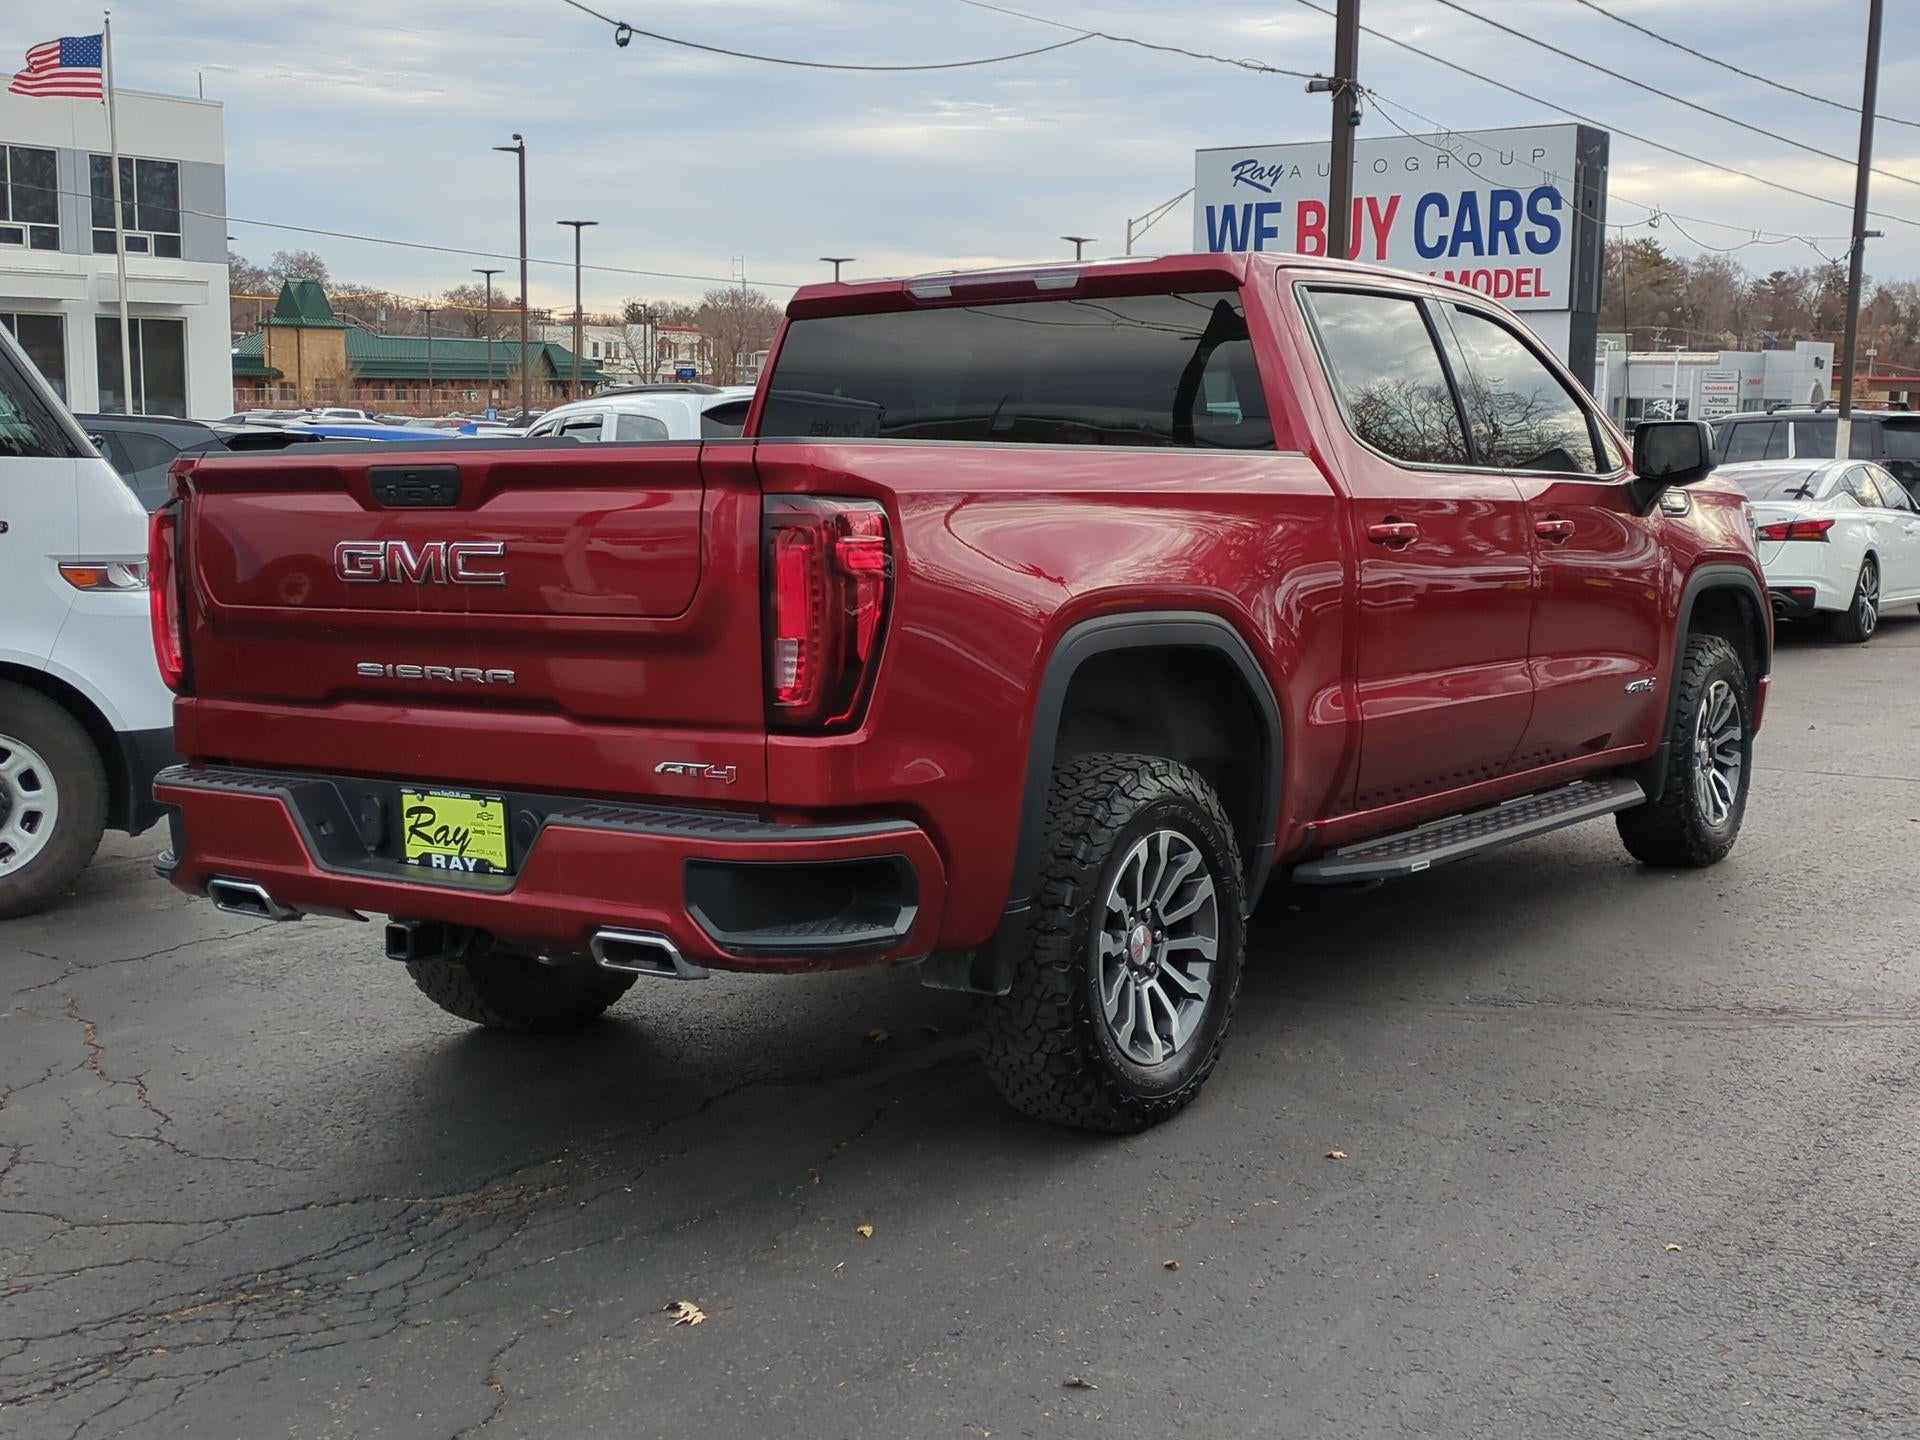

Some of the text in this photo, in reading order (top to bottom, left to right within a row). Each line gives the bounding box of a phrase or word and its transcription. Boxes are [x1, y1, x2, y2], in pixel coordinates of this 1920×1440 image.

[1231, 147, 1546, 193] Ray AUOGROUP
[1206, 202, 1282, 253] WE
[1414, 184, 1562, 259] CARS
[1708, 396, 1729, 405] Jeep
[334, 540, 506, 585] GMC
[356, 662, 516, 685] SIERRA
[655, 761, 737, 784] AT4
[406, 806, 471, 856] Ray
[432, 854, 477, 871] RAY
